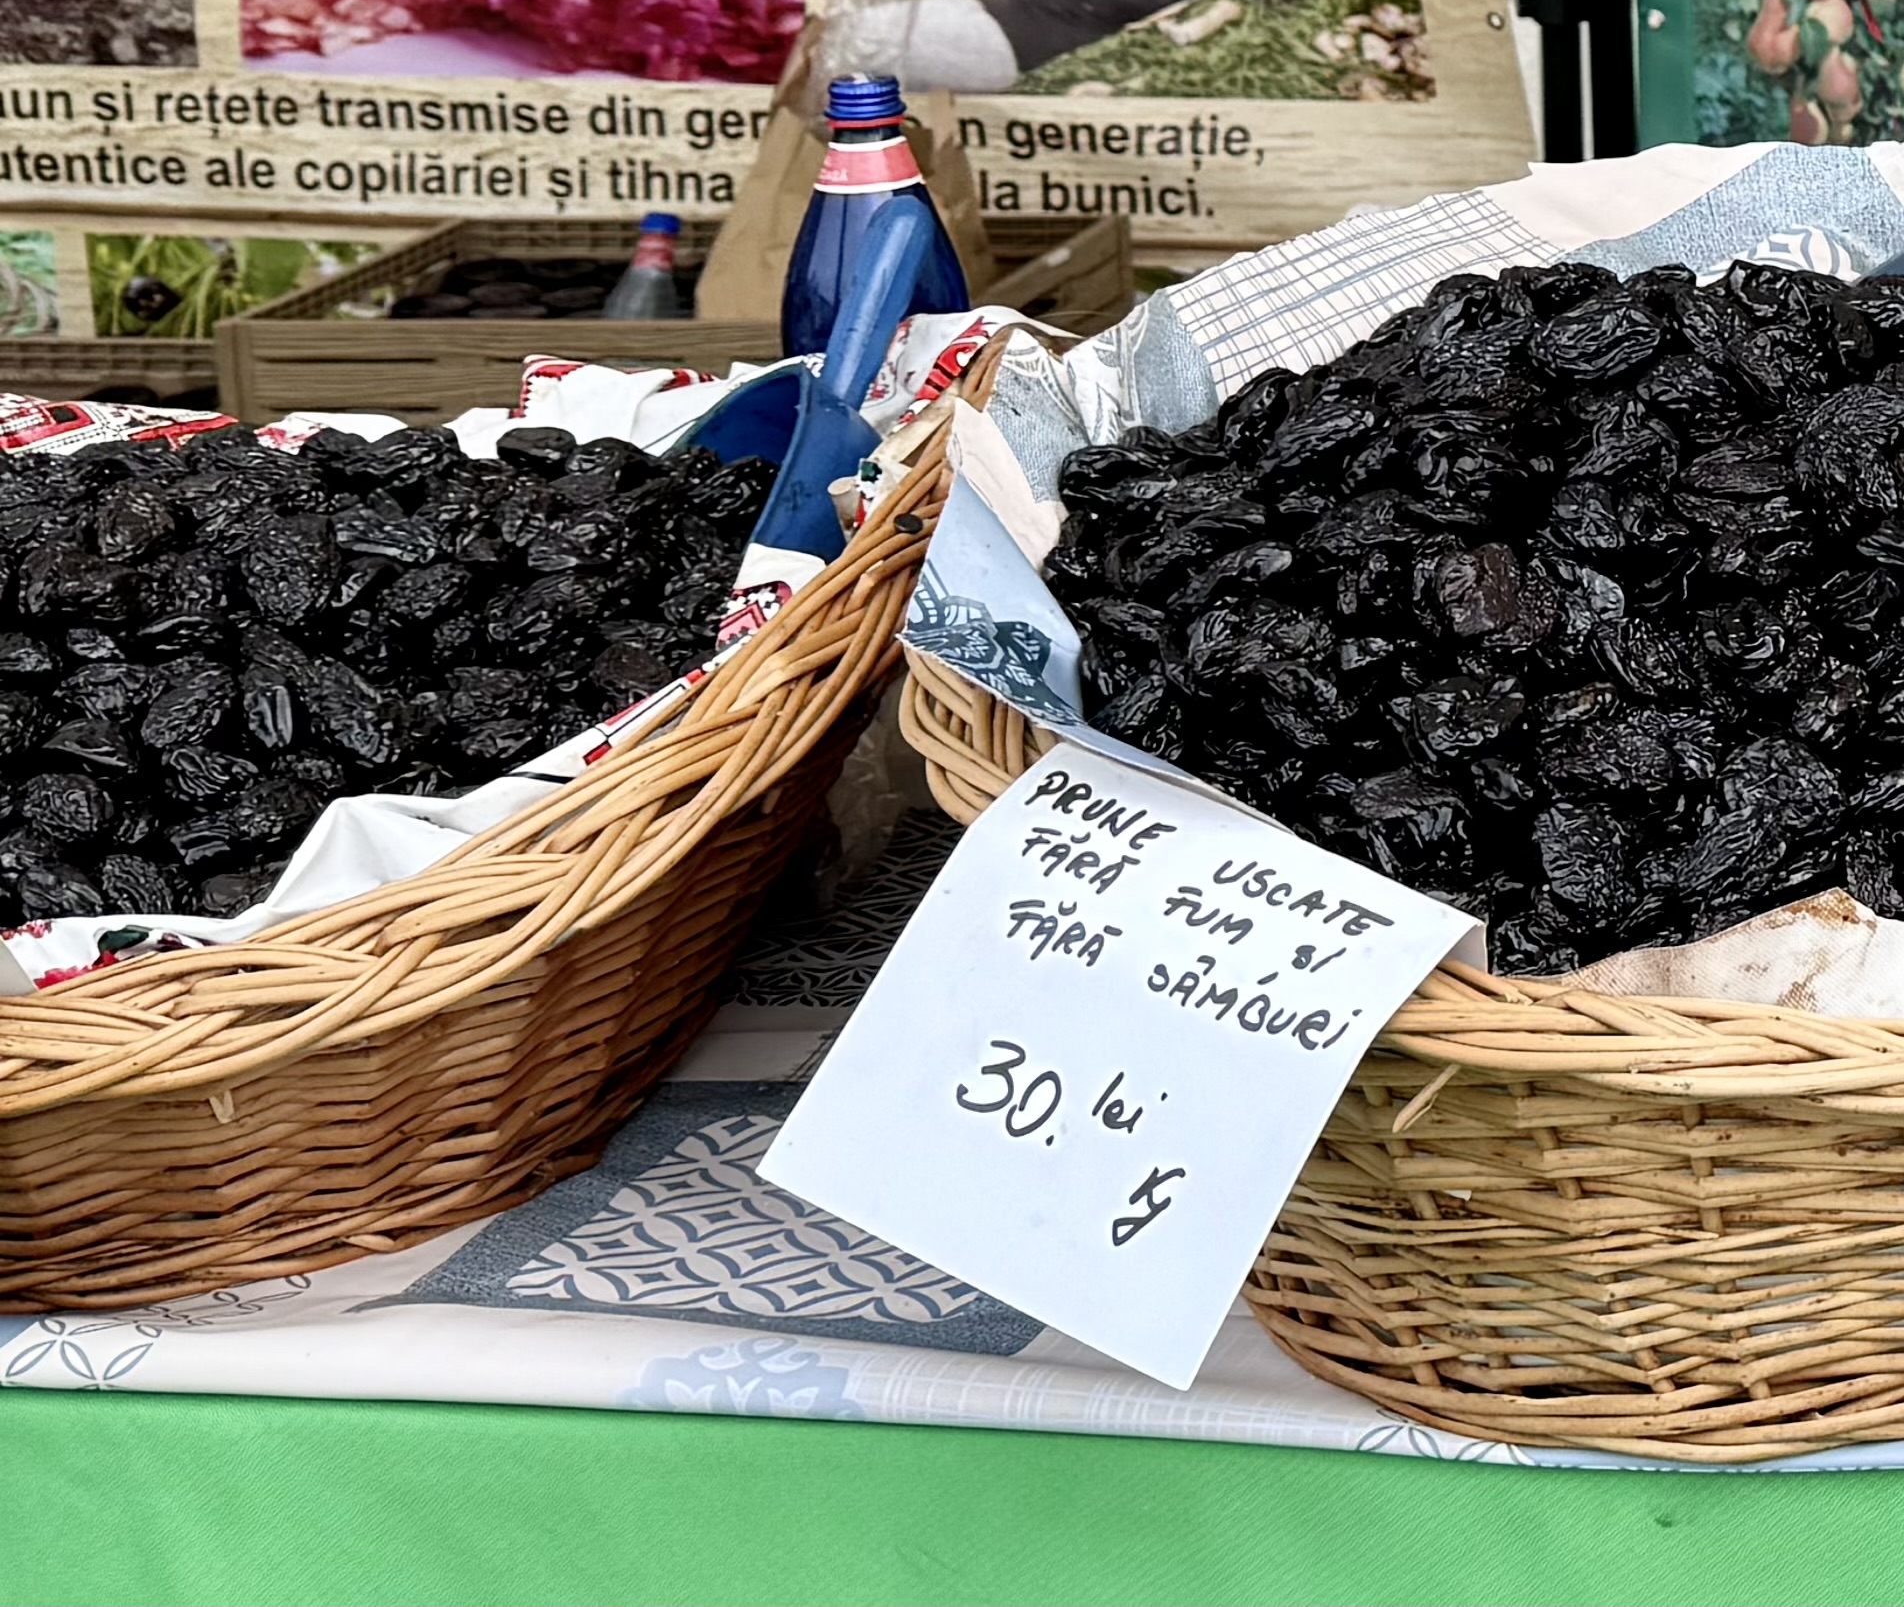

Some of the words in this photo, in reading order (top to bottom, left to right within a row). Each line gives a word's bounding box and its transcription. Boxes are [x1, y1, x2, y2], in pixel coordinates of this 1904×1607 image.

[0, 88, 74, 120] un
[92, 80, 134, 137] și
[156, 86, 299, 140] rețete
[317, 88, 570, 135] transmise
[589, 94, 666, 138] din
[1007, 112, 1266, 172] generație,
[206, 148, 276, 190] ale
[294, 146, 528, 202] copilăriei
[548, 159, 589, 212] și
[609, 158, 734, 202] tihna
[1042, 172, 1214, 219] bunici.
[1021, 826, 1141, 895] FĂRĂ
[1163, 885, 1255, 945] FUM
[1024, 770, 1178, 850] PRUNE
[1213, 859, 1394, 936] USCATE
[1007, 899, 1123, 967] FĂRĂ
